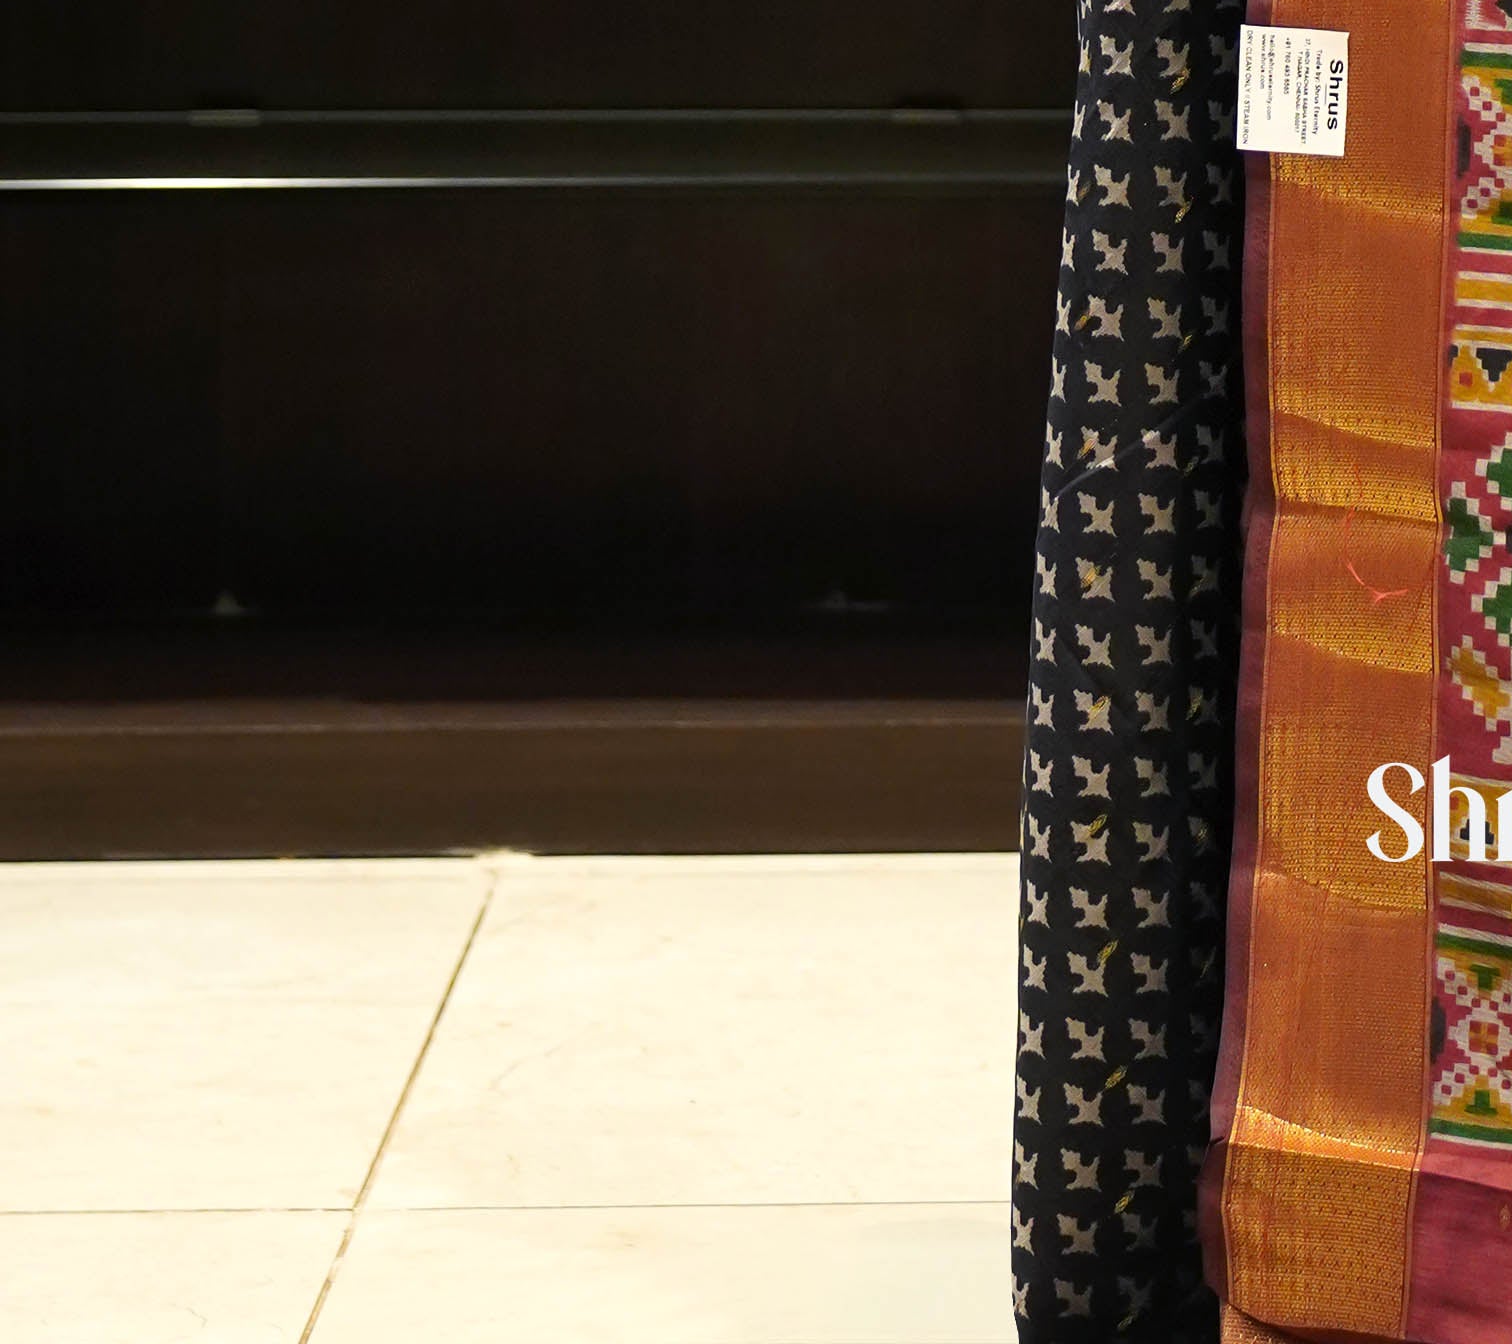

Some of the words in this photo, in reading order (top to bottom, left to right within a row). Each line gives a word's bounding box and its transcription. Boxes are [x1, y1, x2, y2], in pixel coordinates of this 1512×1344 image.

[1328, 60, 1343, 130] Shrus
[1312, 106, 1320, 134] Eternity
[1242, 127, 1250, 144] IRON
